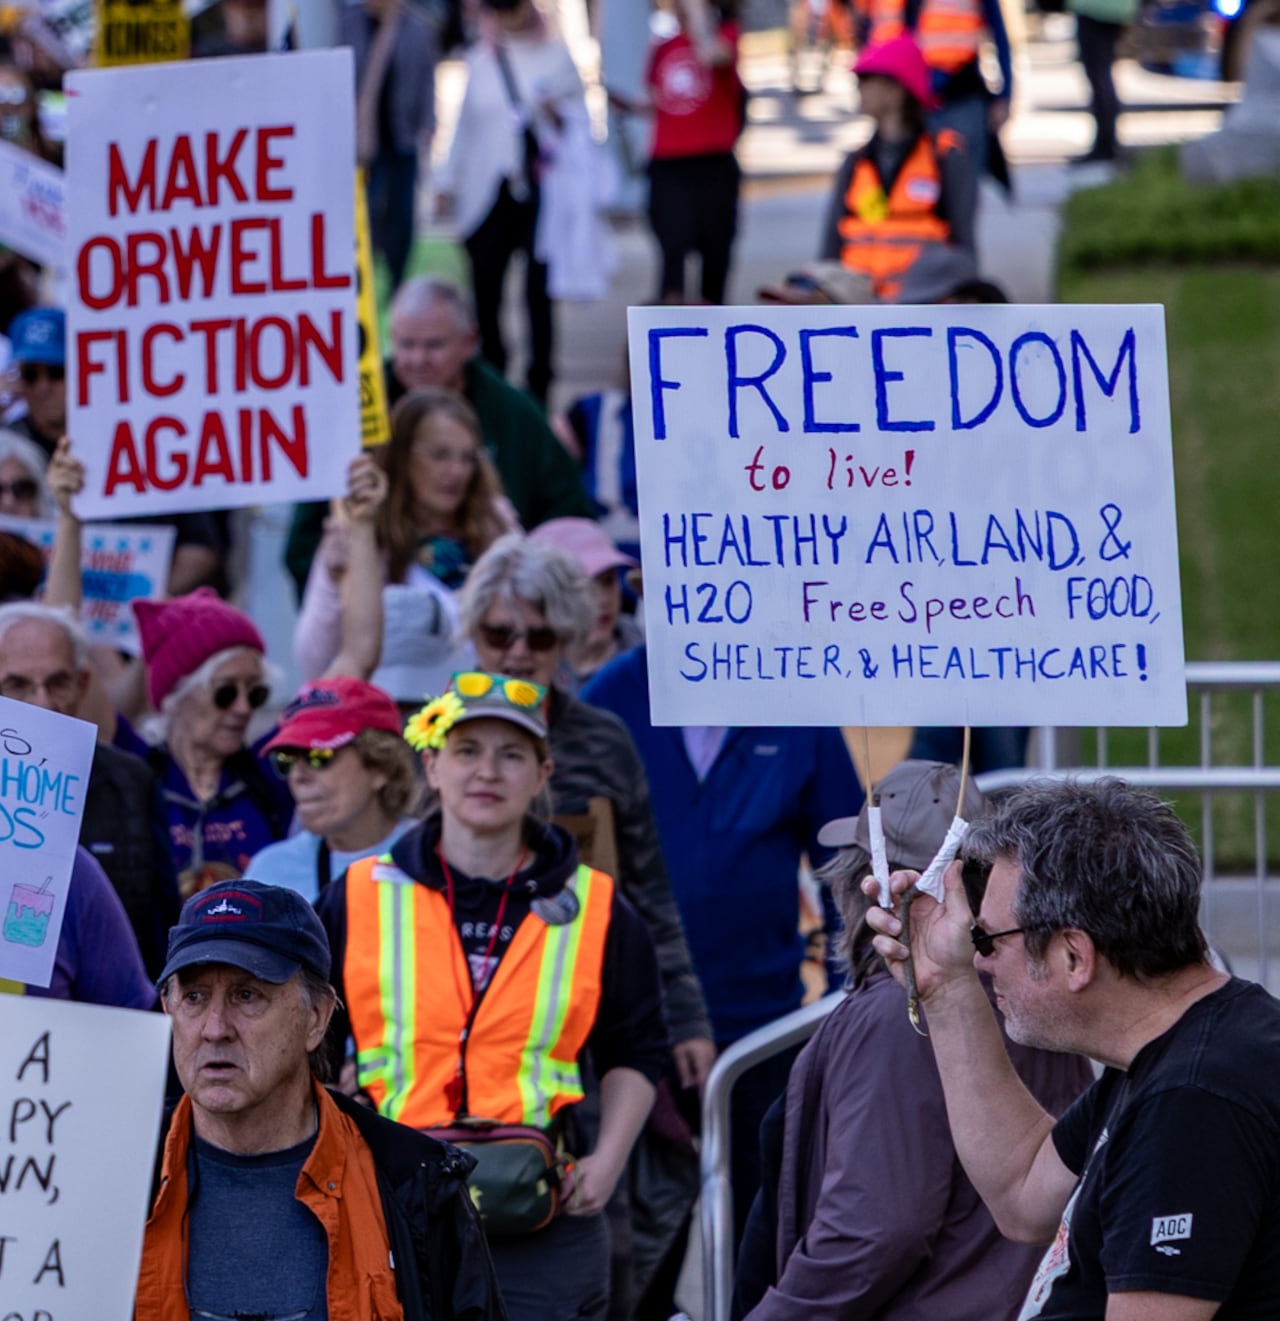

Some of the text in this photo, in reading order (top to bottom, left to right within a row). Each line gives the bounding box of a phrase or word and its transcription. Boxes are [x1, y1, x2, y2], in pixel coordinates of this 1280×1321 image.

[108, 125, 295, 218] MAKE
[76, 212, 352, 310] ORWELL
[76, 310, 345, 407] FICTION
[647, 324, 1142, 440] FREEDOM
[102, 404, 308, 496] AGAIN
[744, 445, 916, 491] to live!
[662, 503, 1132, 571] HEALTHY AIR, LAND, &
[801, 581, 890, 623] Free
[898, 576, 1037, 633] Speech
[1066, 574, 1161, 626] FOOD,
[679, 641, 1149, 683] SHELTER, & HEALTHCARE!
[1, 757, 80, 816] HOME
[17, 1031, 52, 1083] A
[1155, 1217, 1187, 1238] AOC
[34, 1239, 67, 1288] A
